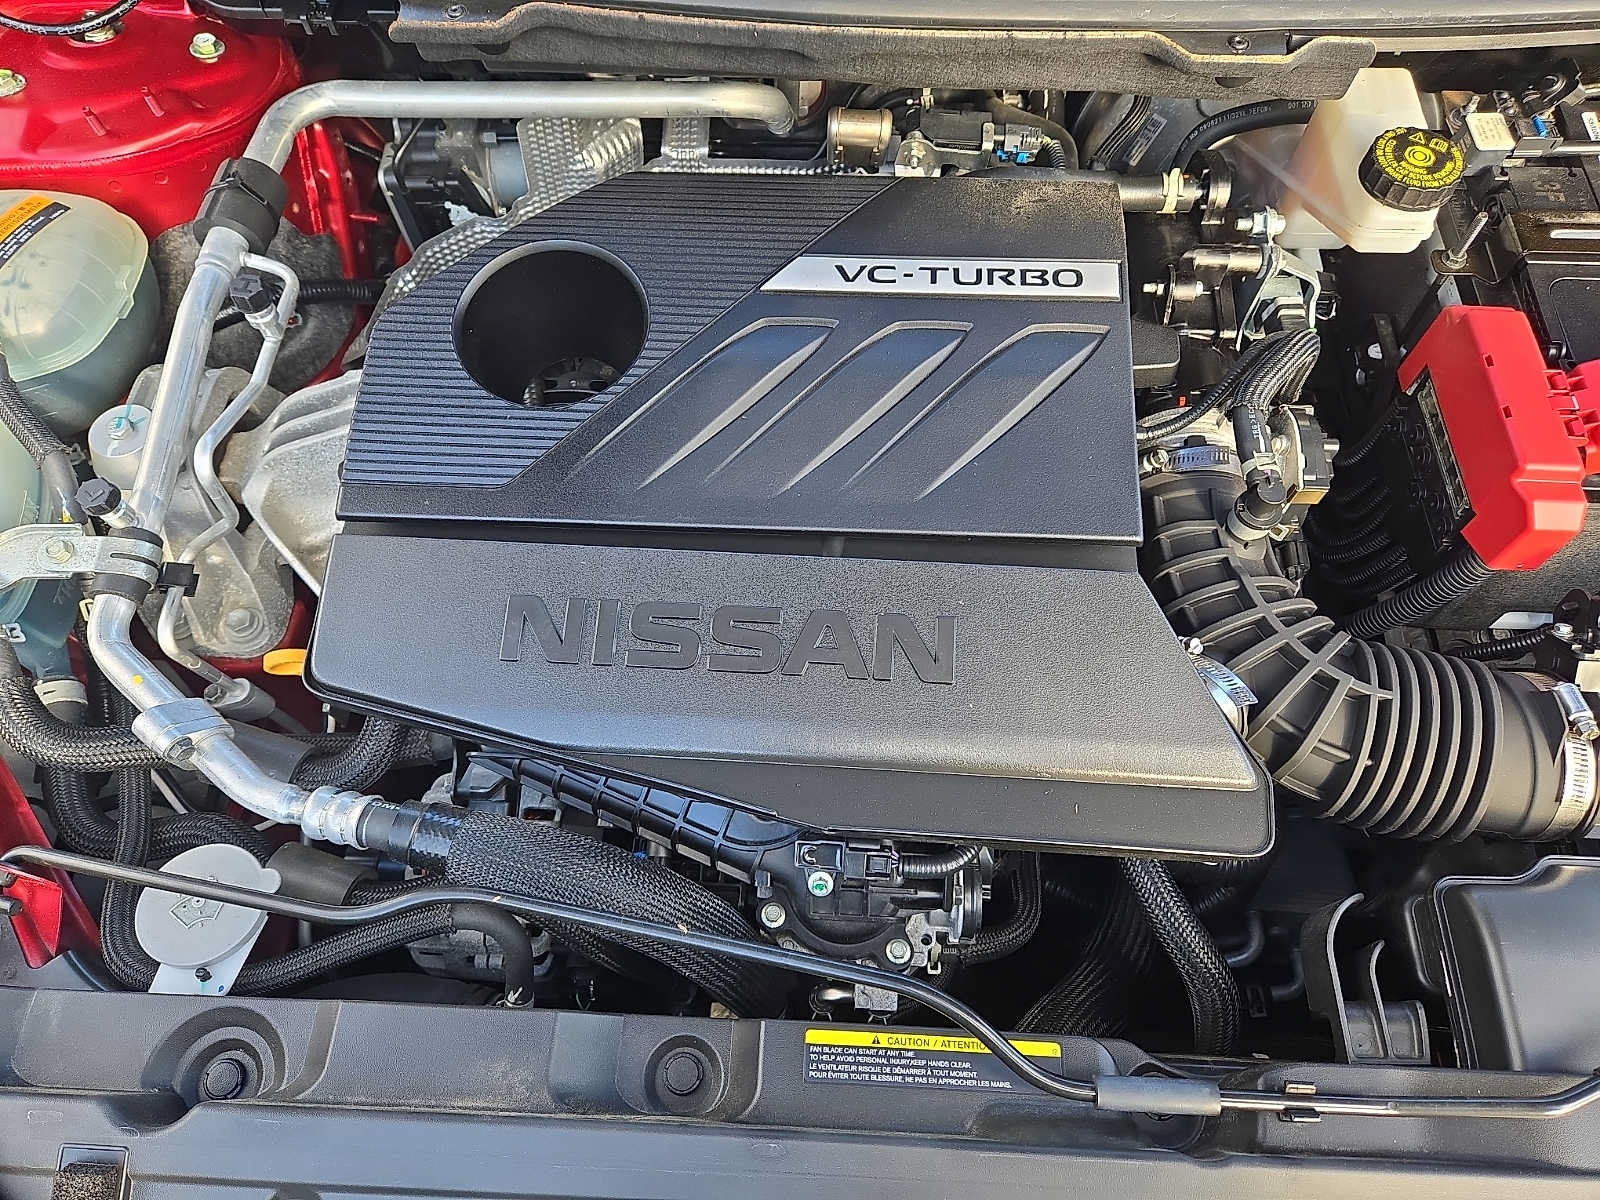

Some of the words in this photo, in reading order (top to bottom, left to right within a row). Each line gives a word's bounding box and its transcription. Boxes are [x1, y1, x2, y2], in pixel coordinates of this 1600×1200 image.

[834, 264, 1084, 288] VC-TURBO
[499, 594, 958, 685] NISSAN
[887, 1036, 930, 1047] CAUTION
[940, 1039, 987, 1050] ATTENTIO
[844, 1047, 857, 1055] CAN
[856, 1056, 889, 1064] PERSONAL
[927, 1060, 949, 1068] HANDS
[818, 1063, 857, 1072] VENTILATEUR
[892, 1066, 926, 1075] DÉMARRER
[932, 1069, 949, 1077] TOUT
[809, 1071, 827, 1079] POUR
[828, 1071, 848, 1080] ÉVITER
[938, 1078, 977, 1087] APPROCHER
[977, 1080, 990, 1088] LES
